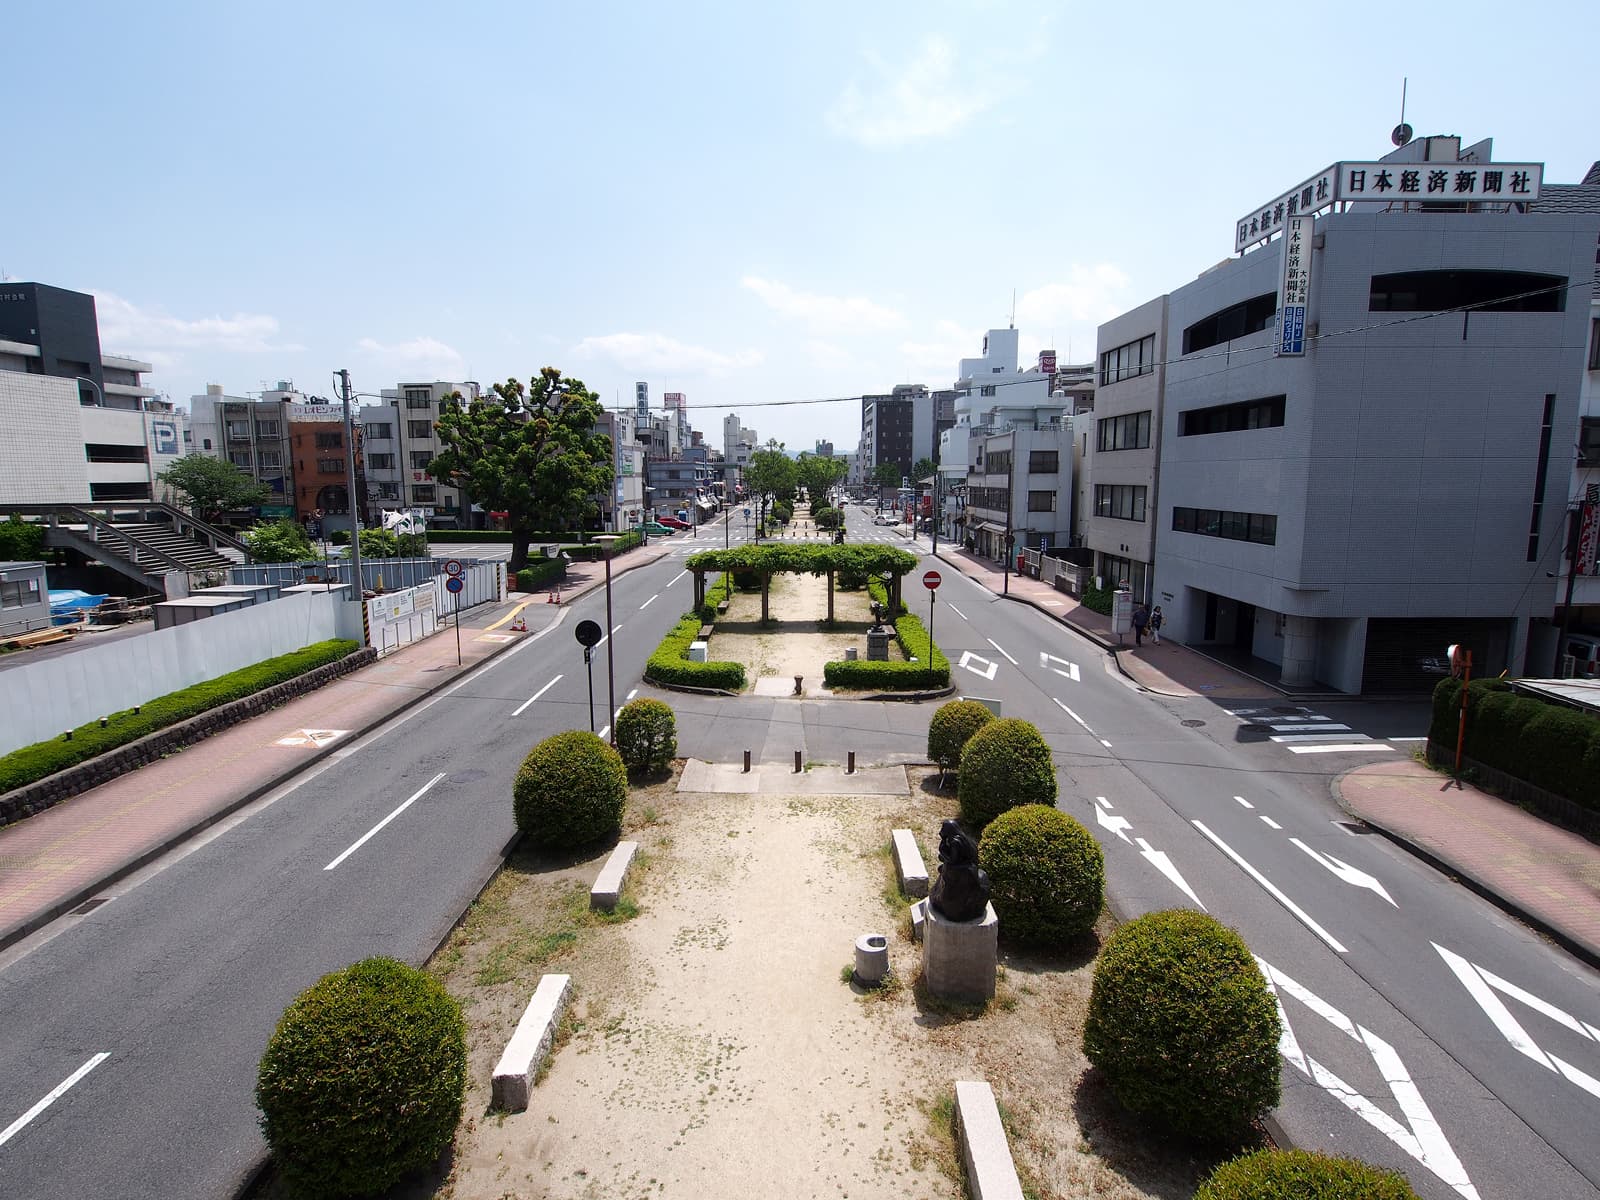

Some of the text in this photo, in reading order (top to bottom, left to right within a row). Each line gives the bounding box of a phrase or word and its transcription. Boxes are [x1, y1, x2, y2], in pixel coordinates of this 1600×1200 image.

[1349, 169, 1531, 194] 日本経済新聞社
[1239, 176, 1329, 243] 日本経済新聞社
[1287, 220, 1302, 304] 日本経済新聞社
[155, 424, 175, 451] P
